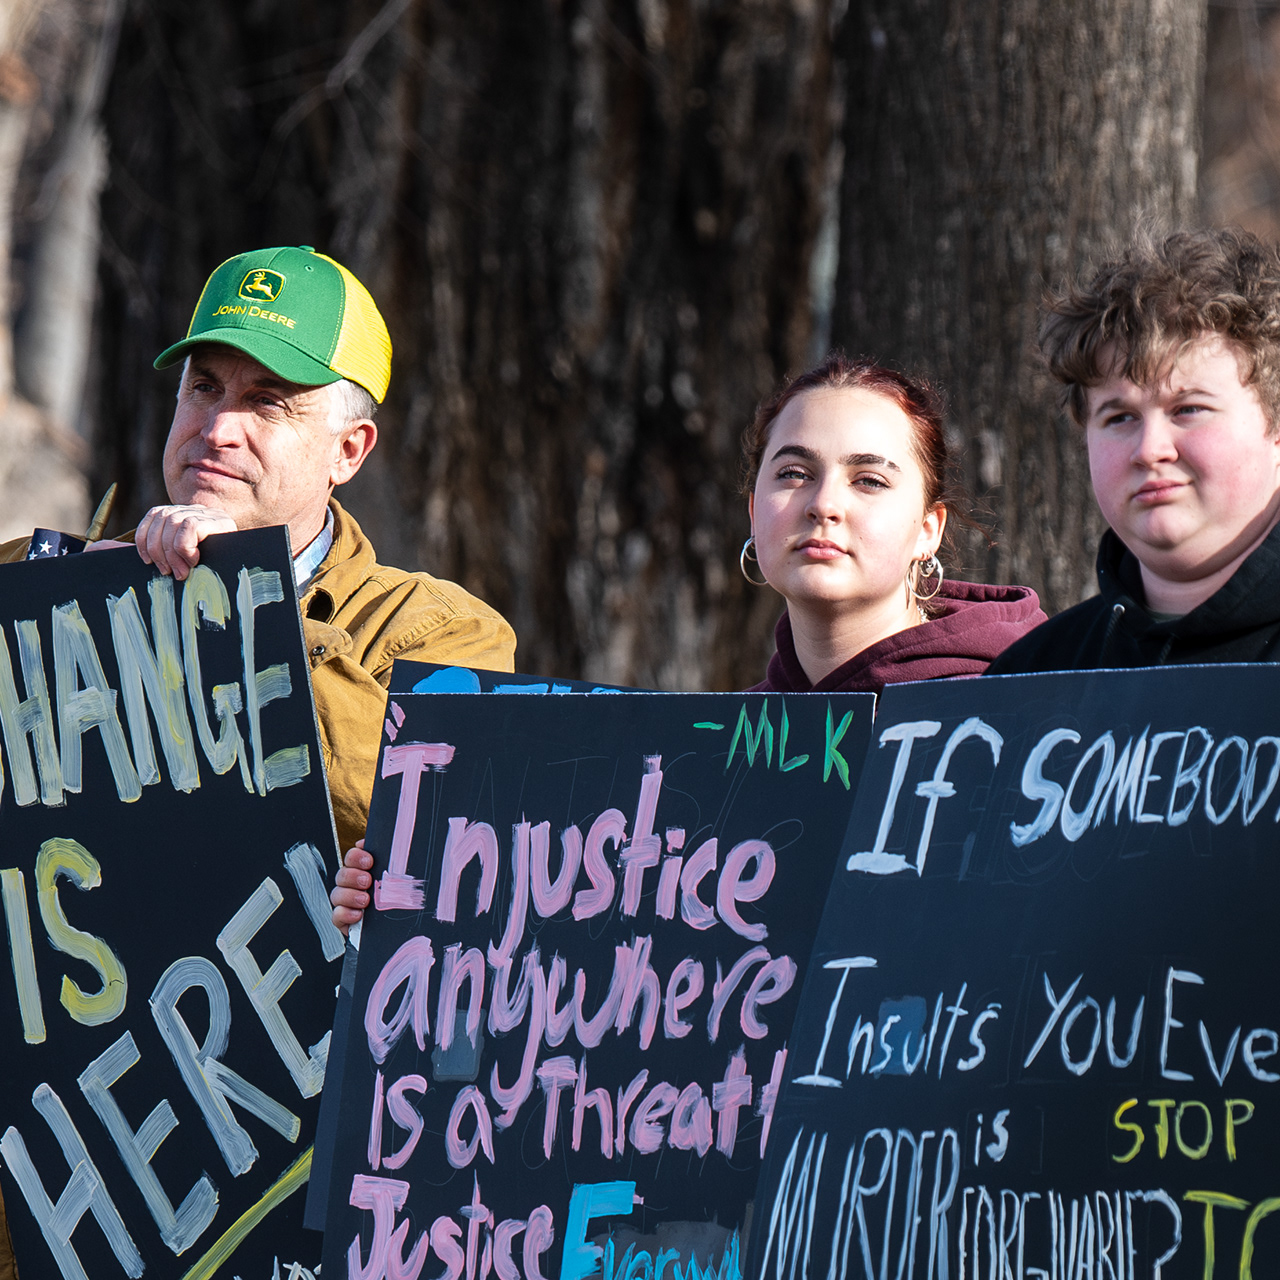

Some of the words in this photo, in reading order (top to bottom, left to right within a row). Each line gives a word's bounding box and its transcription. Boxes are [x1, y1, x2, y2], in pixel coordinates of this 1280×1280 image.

[212, 305, 247, 316] JOHN
[248, 306, 297, 329] DEERE
[0, 837, 127, 1044] IS
[364, 933, 798, 1132] anywhere
[792, 956, 1002, 1088] Insults
[445, 1084, 495, 1169] a
[1112, 1098, 1255, 1163] STOP
